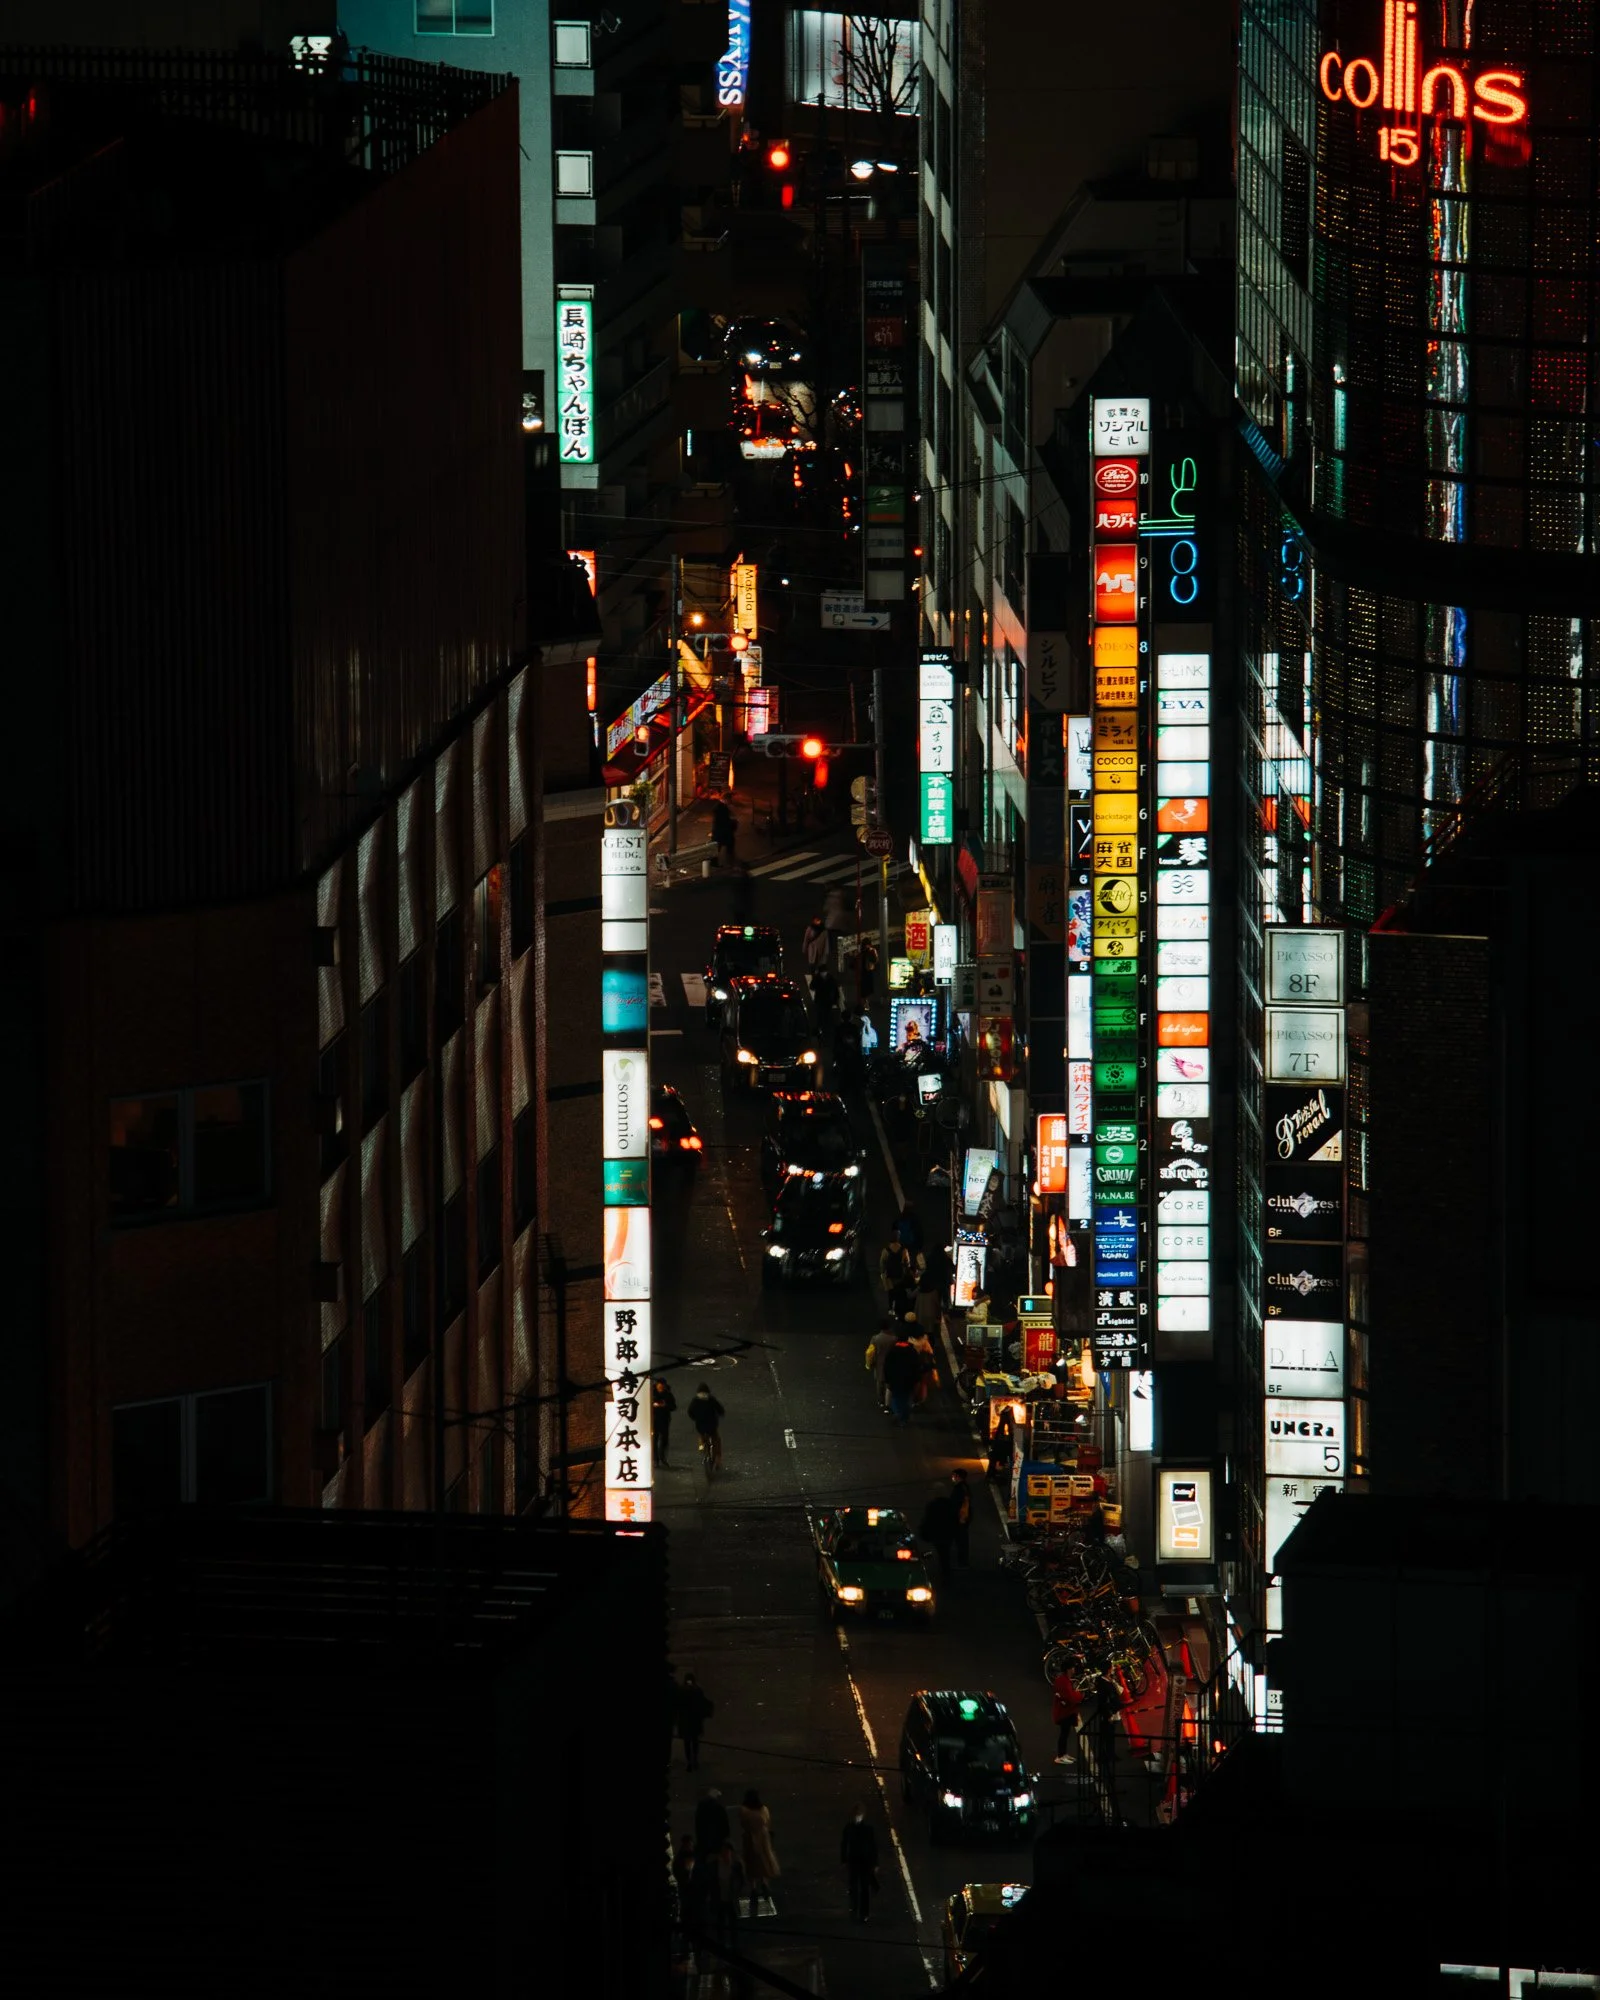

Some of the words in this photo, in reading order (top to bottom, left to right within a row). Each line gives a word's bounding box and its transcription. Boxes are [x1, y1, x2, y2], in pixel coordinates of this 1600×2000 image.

[1320, 0, 1528, 124] collins
[1378, 126, 1420, 166] 15
[563, 308, 590, 458] 長崎ちゃんぽん
[1109, 435, 1139, 446] ビル
[1140, 557, 1148, 568] 9
[746, 568, 754, 611] Masala
[1140, 597, 1147, 608] F
[1140, 641, 1148, 653] 8
[1040, 640, 1057, 702] シルビア
[1140, 681, 1147, 693] F
[1160, 700, 1205, 710] EVA
[1098, 724, 1134, 738] ミライ
[1097, 756, 1134, 766] cocoa
[1139, 808, 1148, 820] 6
[604, 837, 645, 849] GEST
[1096, 841, 1132, 854] 麻雀
[1140, 848, 1147, 860] F
[1097, 857, 1133, 868] 天国
[1140, 891, 1147, 903] 5
[906, 922, 927, 950] 酒
[1140, 931, 1146, 942] F
[1277, 950, 1334, 962] PICASSO
[1140, 974, 1148, 985] 4
[1289, 973, 1321, 994] 8F
[1140, 1013, 1147, 1025] F
[1277, 1031, 1334, 1042] PICASSO
[1139, 1056, 1147, 1069] 3
[1289, 1052, 1320, 1073] 7F
[618, 1083, 633, 1150] somnio
[1139, 1139, 1148, 1151] 2
[1192, 1143, 1209, 1153] 2F
[1326, 1146, 1339, 1158] 7F
[1194, 1180, 1209, 1189] 1F
[1162, 1201, 1205, 1210] CORE
[1140, 1222, 1147, 1233] 1
[1268, 1227, 1283, 1237] 6F
[1162, 1236, 1205, 1246] CORE
[1140, 1261, 1147, 1273] F
[1140, 1303, 1148, 1315] B
[1268, 1305, 1283, 1316] 6F
[1269, 1385, 1283, 1394] 5F
[614, 1309, 642, 1483] 野郎寿司本店
[1323, 1446, 1340, 1473] 5
